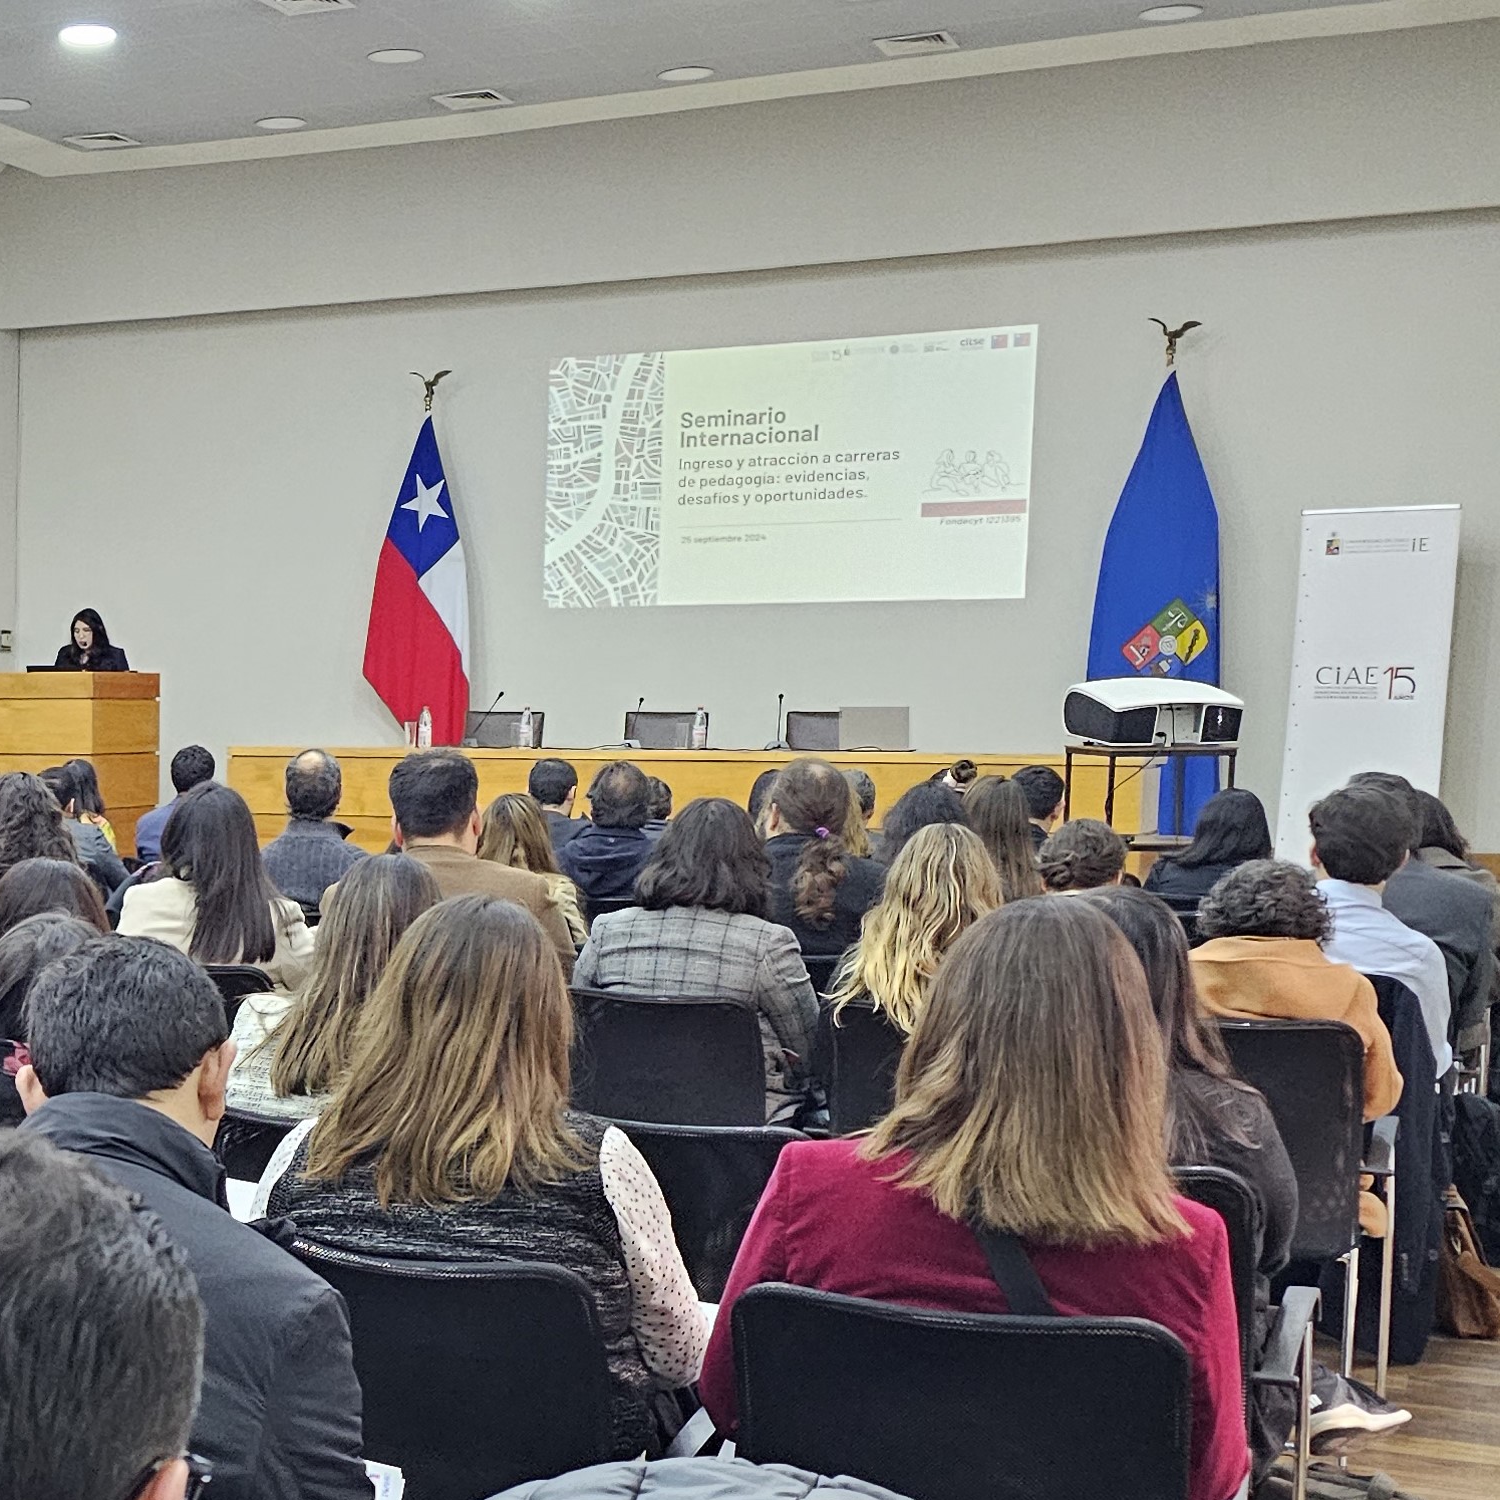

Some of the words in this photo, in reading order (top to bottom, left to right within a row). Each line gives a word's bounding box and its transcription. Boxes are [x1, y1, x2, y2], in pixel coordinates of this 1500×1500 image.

[681, 407, 786, 428] Seminario
[681, 424, 819, 448] Internacional
[679, 458, 733, 472] Ingreso
[737, 458, 745, 471] y
[822, 454, 831, 464] a
[835, 450, 900, 463] carreras
[678, 476, 696, 488] de
[785, 468, 869, 483] evidencias,
[743, 494, 751, 507] y
[754, 487, 868, 504] oportunidades.
[1382, 666, 1417, 700] 15
